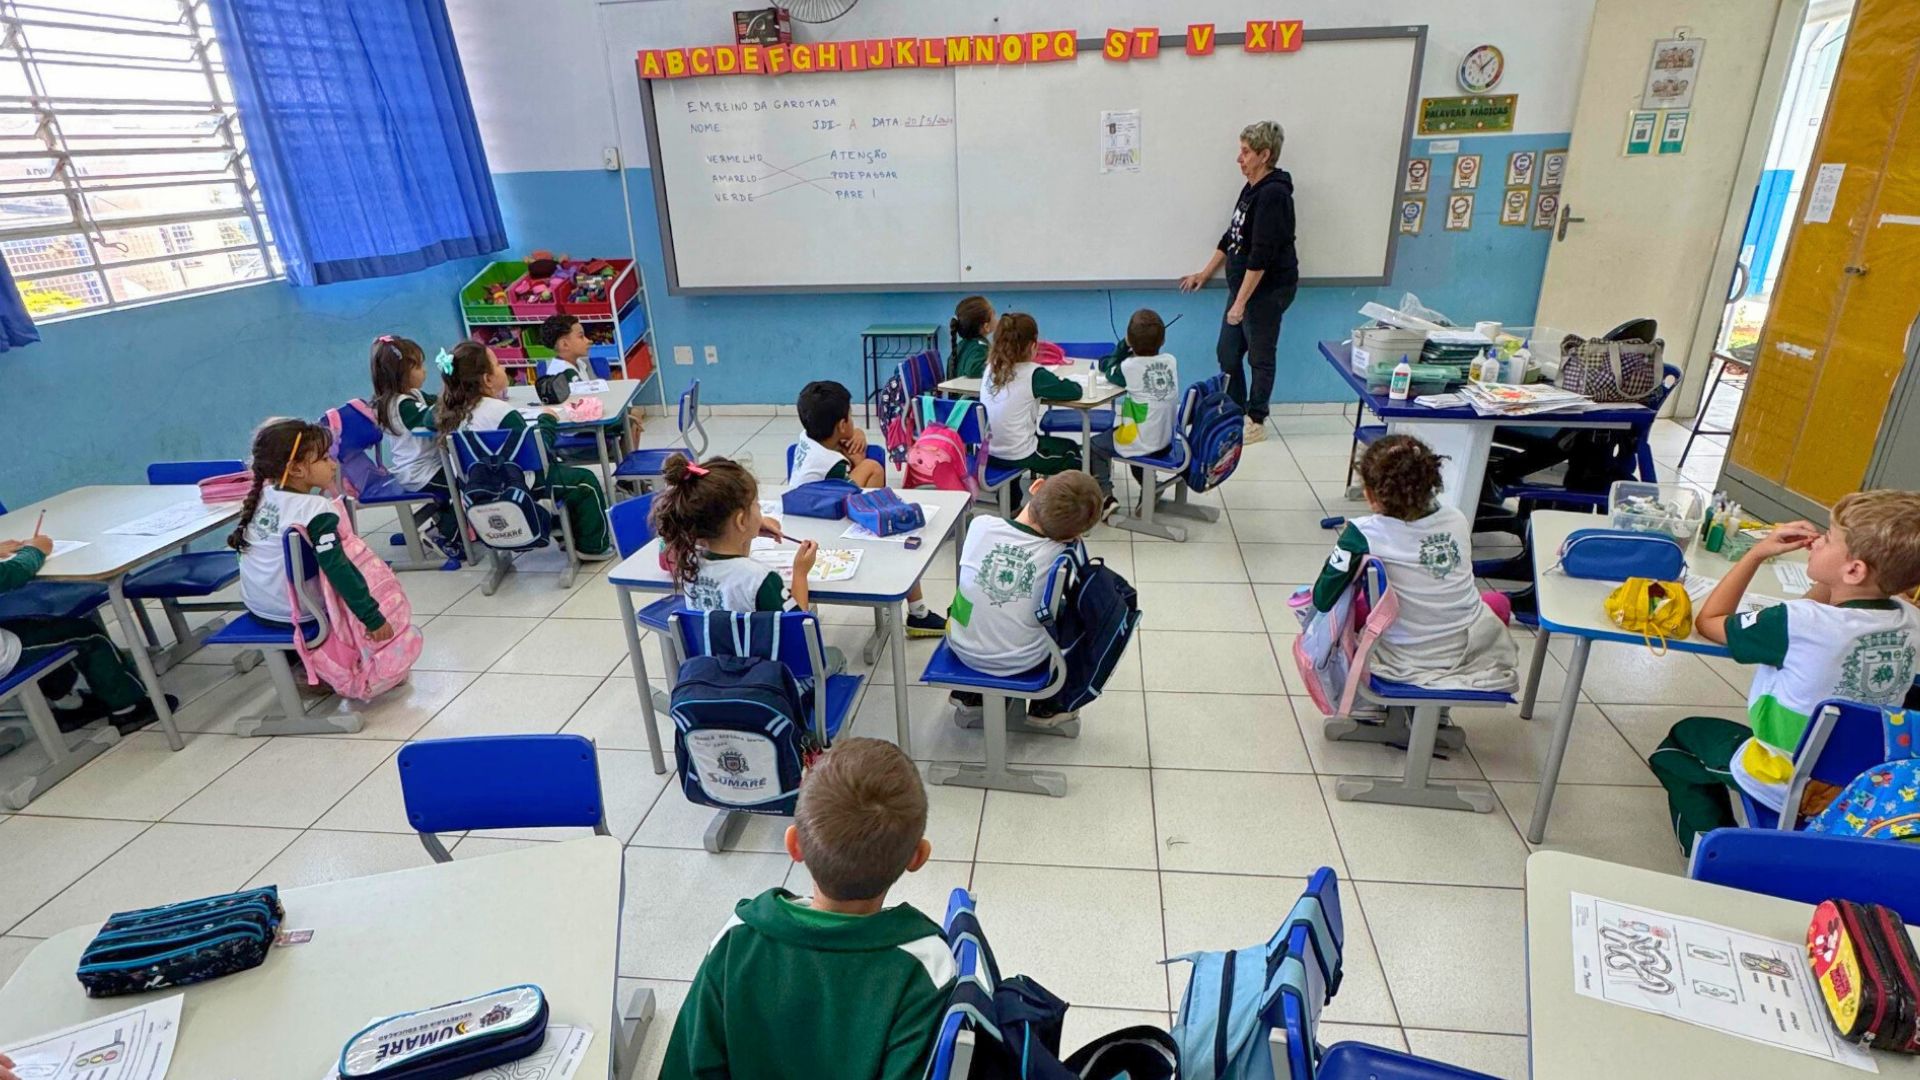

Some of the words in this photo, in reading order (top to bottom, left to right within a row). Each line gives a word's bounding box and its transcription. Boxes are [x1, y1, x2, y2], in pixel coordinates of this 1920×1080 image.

[644, 52, 660, 74] A
[665, 50, 685, 76] B
[691, 48, 709, 74] C
[716, 48, 736, 72] D
[743, 46, 758, 71] E
[768, 48, 783, 71] F
[792, 44, 811, 70] G
[818, 44, 836, 67] H
[850, 45, 857, 65] I
[870, 43, 884, 67] J
[897, 41, 914, 64] K
[925, 41, 940, 64] L
[946, 36, 970, 62] M
[975, 37, 994, 61] N
[1002, 34, 1022, 63] O
[1031, 32, 1048, 61] P
[1053, 32, 1074, 58] Q
[1106, 31, 1126, 58] S
[1137, 32, 1153, 52] T
[1192, 27, 1211, 50] V
[1249, 23, 1267, 48] X
[1280, 23, 1297, 48] Y
[754, 100, 768, 111] DA
[773, 98, 836, 110] GAROTADA
[1425, 108, 1467, 119] PALAVRAS
[690, 123, 721, 134] NOME
[706, 153, 763, 164] VERMELHO
[830, 148, 888, 164] ATENÇÃO
[712, 174, 758, 184] AMARELO
[858, 171, 898, 180] PASSAR
[714, 193, 755, 202] VERDE
[835, 190, 864, 200] PARE
[419, 1023, 429, 1031] DE
